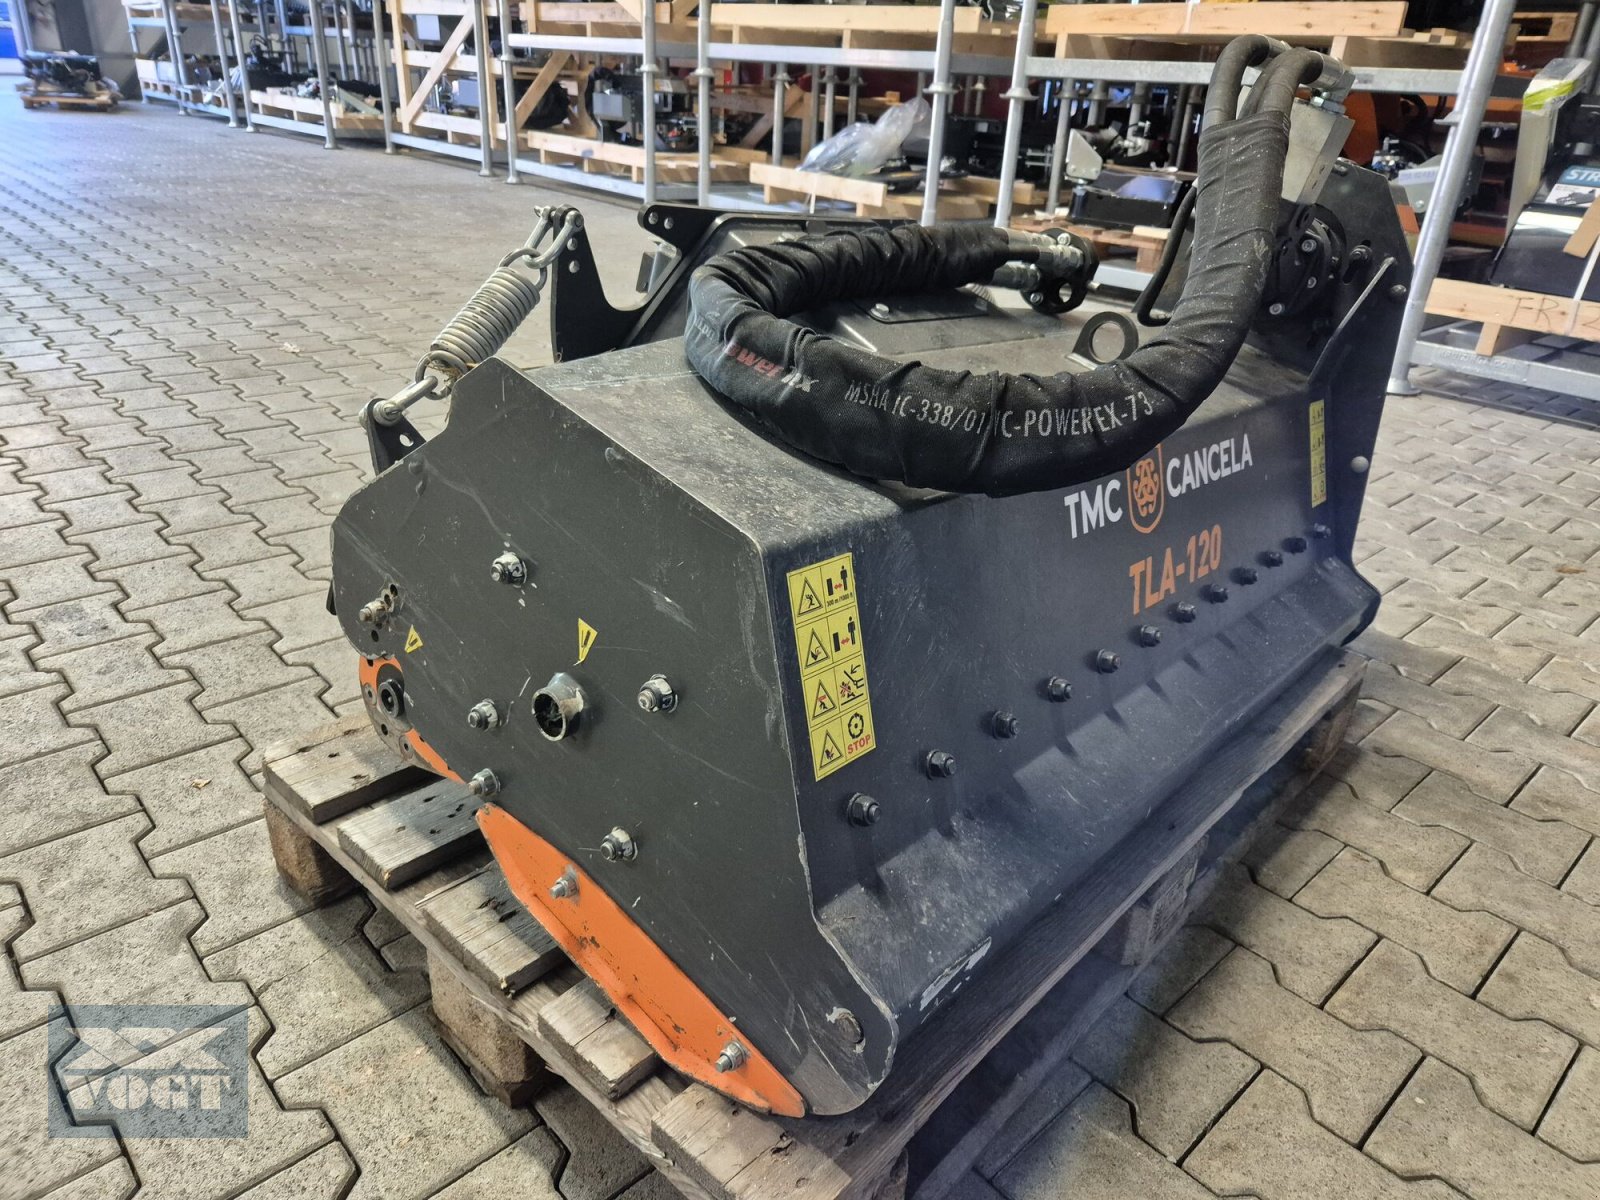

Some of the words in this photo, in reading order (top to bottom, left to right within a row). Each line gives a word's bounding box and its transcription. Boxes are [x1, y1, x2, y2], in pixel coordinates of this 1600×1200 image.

[1064, 479, 1123, 539] TMC
[1166, 433, 1253, 498] CANCELA
[1129, 524, 1222, 616] TLA-120
[847, 734, 871, 754] STOP
